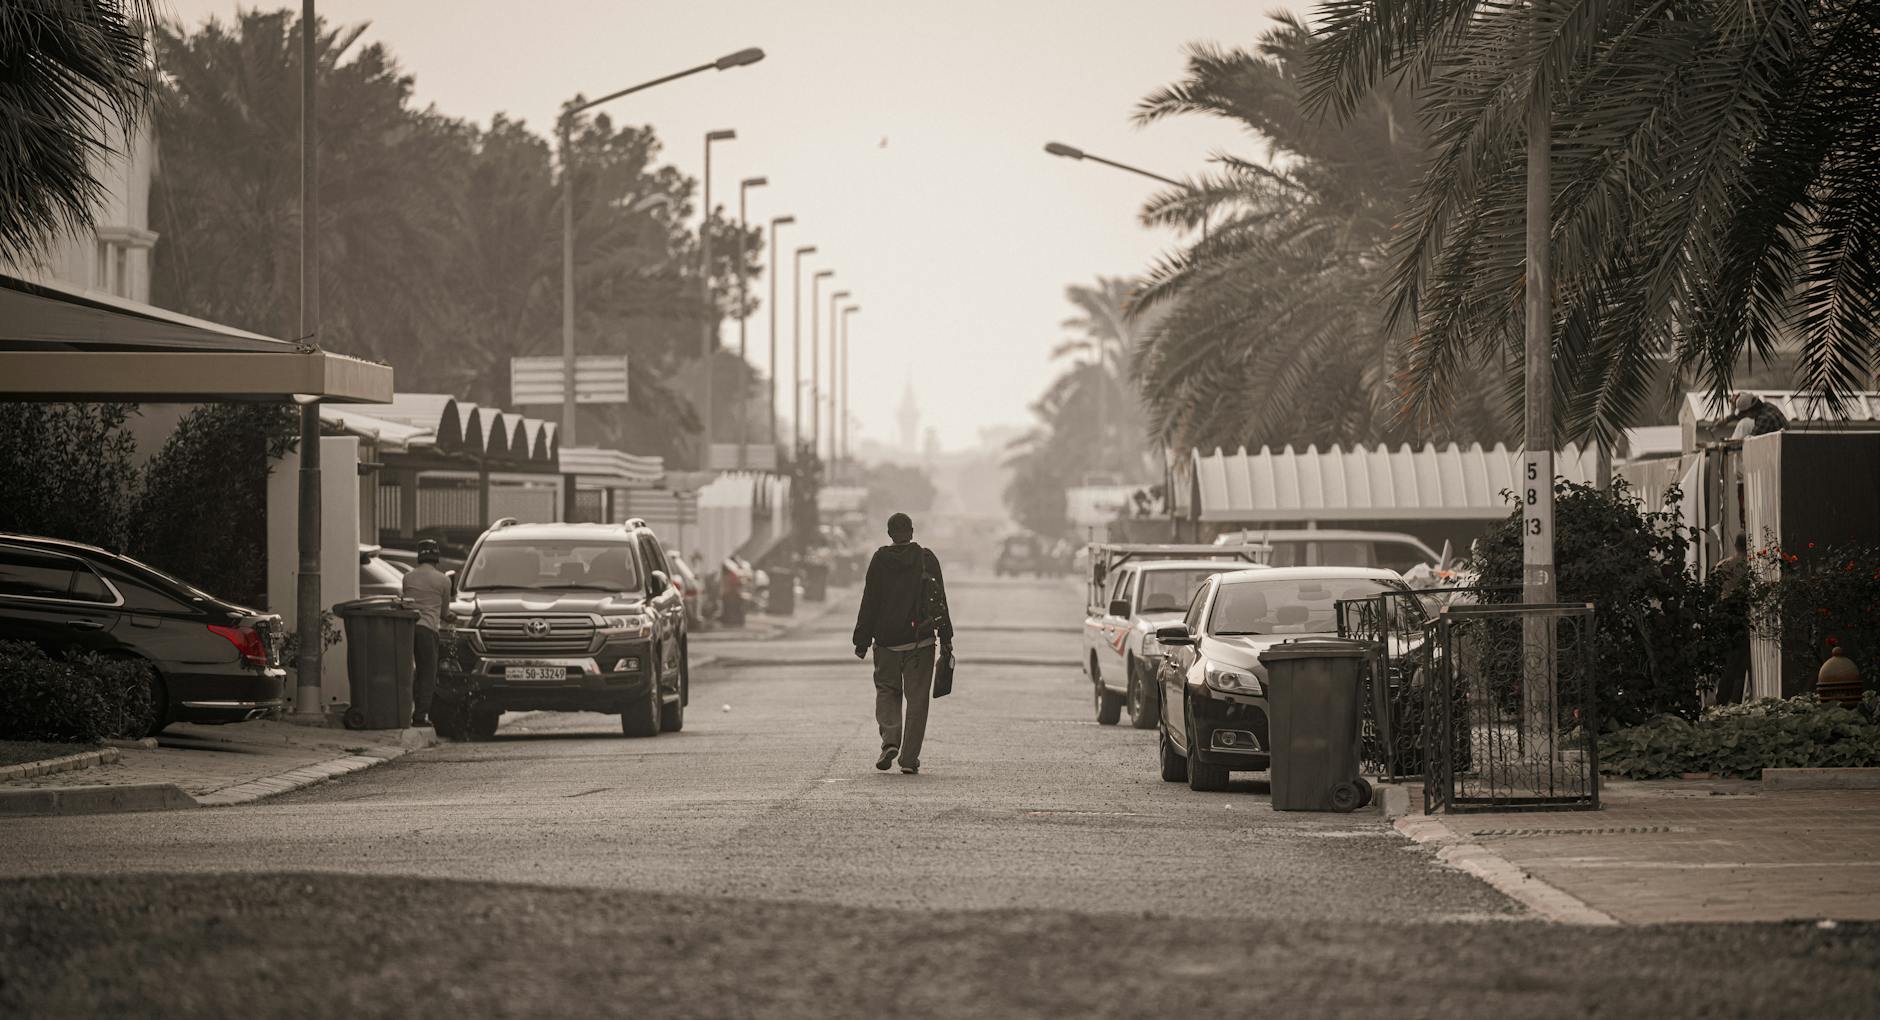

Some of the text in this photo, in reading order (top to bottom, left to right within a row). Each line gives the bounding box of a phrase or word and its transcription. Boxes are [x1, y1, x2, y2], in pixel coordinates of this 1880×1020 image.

[1527, 462, 1537, 480] 5
[1527, 488, 1537, 505] 8
[1525, 518, 1541, 536] 13
[525, 668, 565, 679] 50-33249
